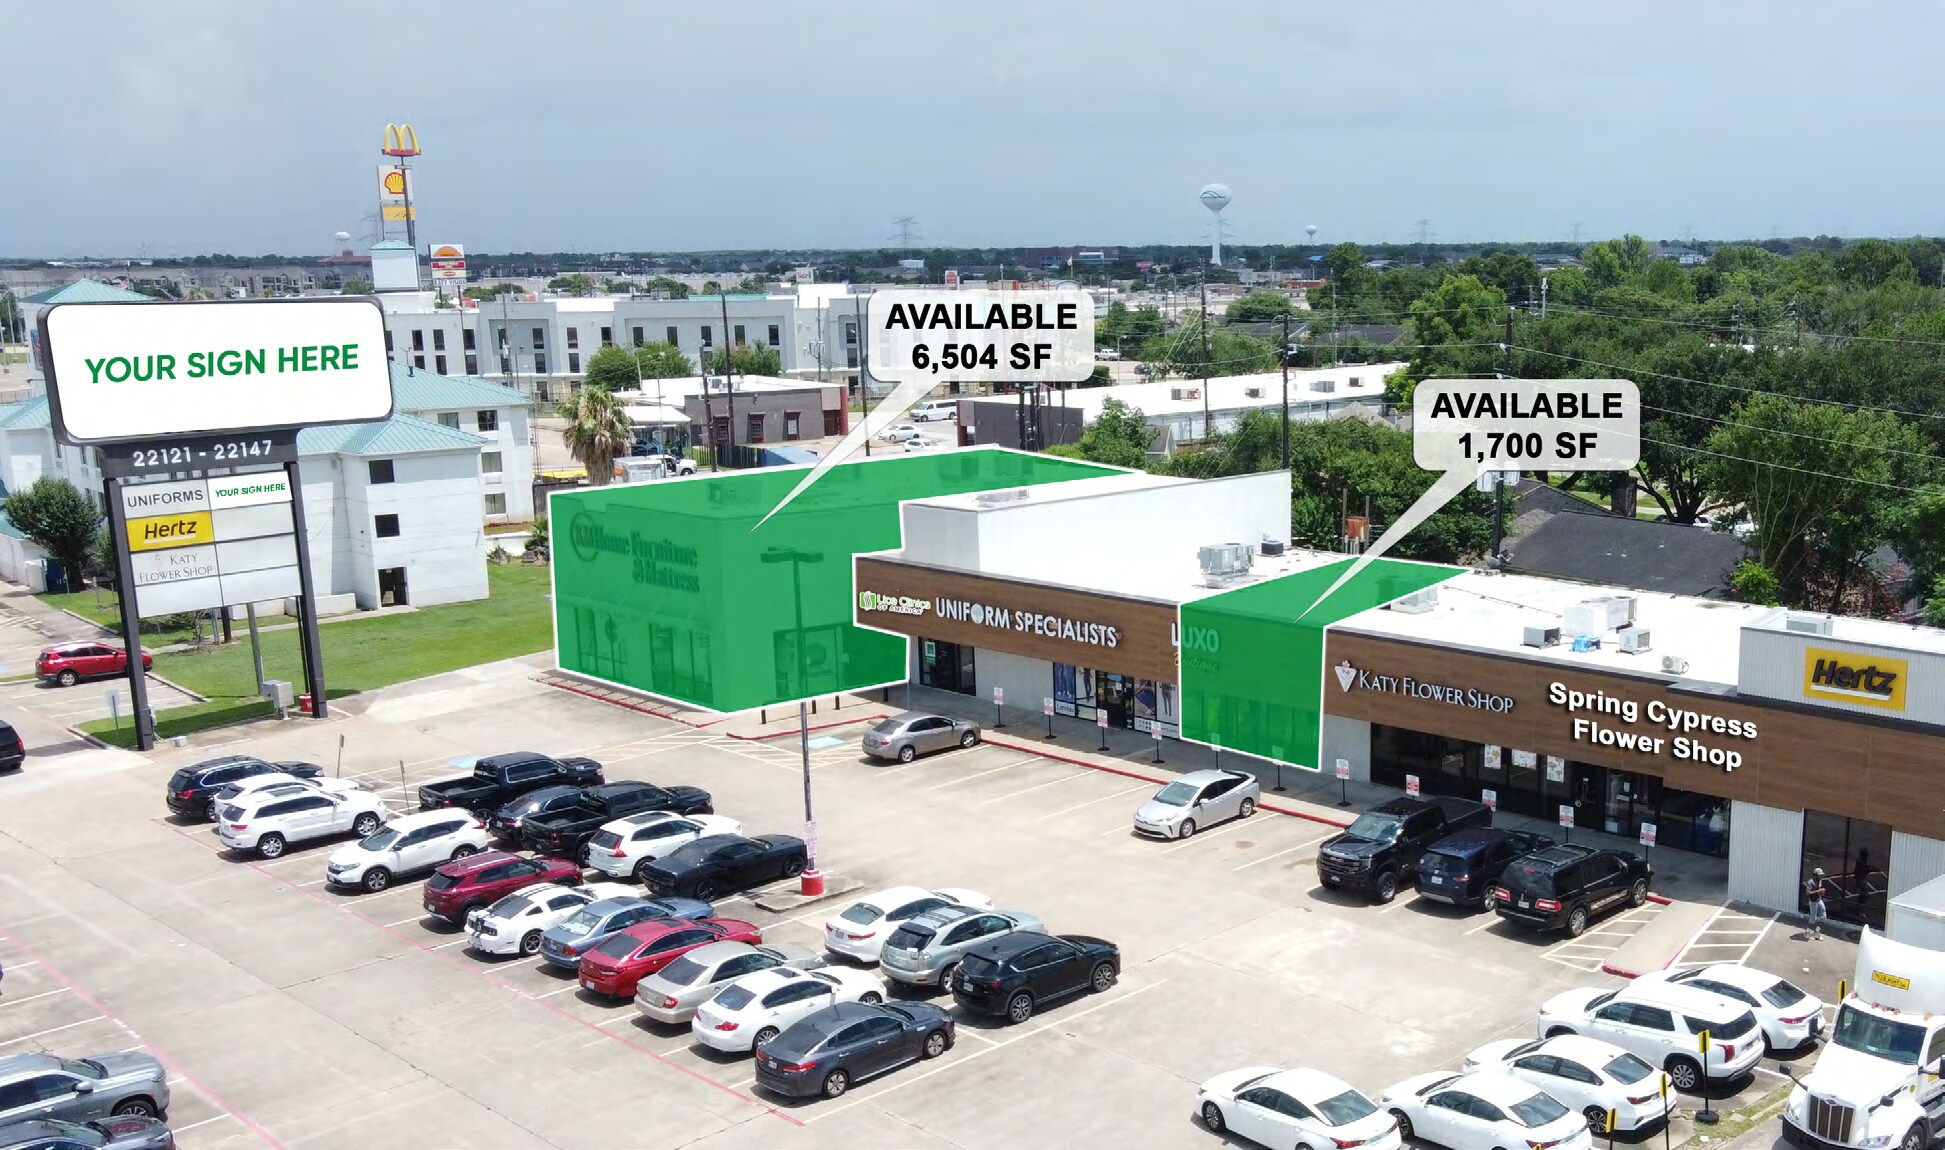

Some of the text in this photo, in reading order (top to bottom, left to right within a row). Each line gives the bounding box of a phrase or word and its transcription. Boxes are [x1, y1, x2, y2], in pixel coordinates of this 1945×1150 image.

[133, 446, 192, 467] 22121
[213, 439, 272, 460] 22147
[127, 489, 204, 508] UNIFORMS
[144, 520, 197, 540] Hertz
[170, 553, 198, 566] KATY
[139, 566, 213, 584] FLOWER SHOP
[876, 593, 931, 610] Lice Clinics
[877, 604, 888, 612] OF
[936, 597, 1118, 648] UNIFORM SPECIALISTS
[1171, 622, 1220, 653] LUXO
[1812, 658, 1897, 694] Hertz
[1359, 669, 1514, 714] KATY FLOWER SHOP
